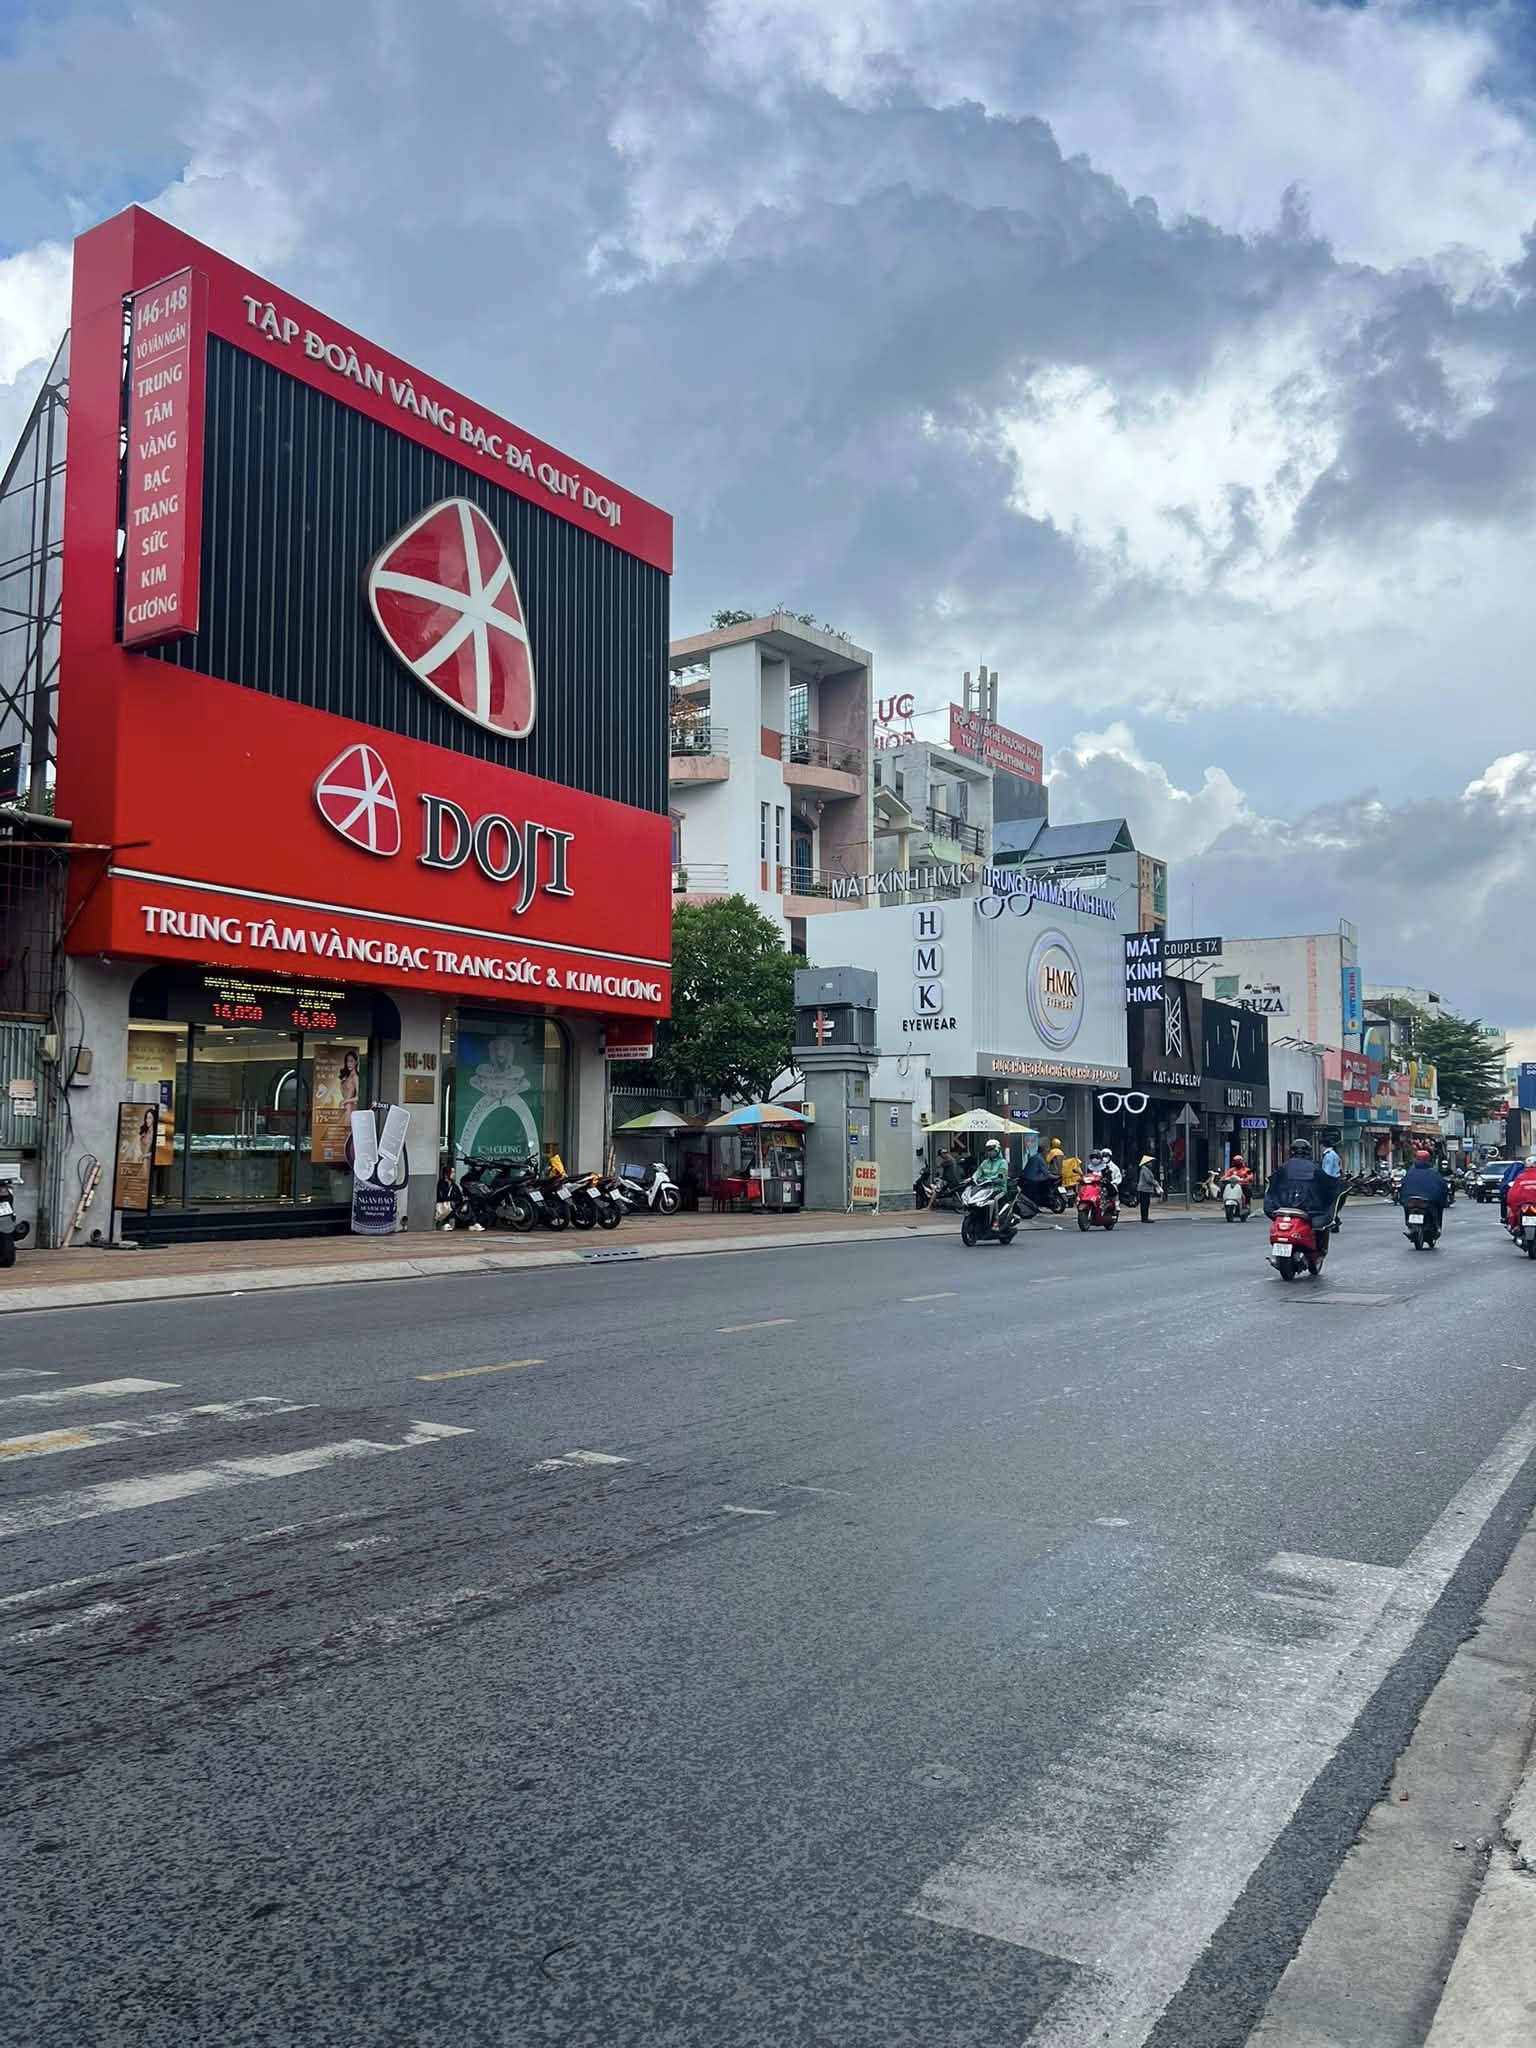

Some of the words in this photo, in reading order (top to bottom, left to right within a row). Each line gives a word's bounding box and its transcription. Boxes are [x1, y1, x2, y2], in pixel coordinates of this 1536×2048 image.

[137, 285, 188, 331] 146-148
[137, 363, 183, 399] TRUNG
[144, 400, 173, 427] TÂM
[242, 294, 300, 344] TẬP
[303, 329, 384, 396] ĐOÀN
[388, 376, 456, 435] VÀNG
[459, 417, 502, 459] BẠC
[506, 442, 536, 480] ĐÁ
[537, 463, 581, 502] QUÝ
[582, 485, 622, 527] DOJI
[139, 431, 177, 460] VÀNG
[143, 465, 171, 492] BẠC
[133, 494, 179, 527] TRANG
[141, 530, 169, 556] SỨC
[141, 563, 167, 589] KIM
[128, 592, 177, 624] CƯƠNG
[416, 793, 575, 914] DOJI
[874, 867, 919, 894] KÍNH
[924, 863, 973, 888] HMK
[982, 864, 1024, 893] TRUNG
[140, 905, 243, 945] TRUNG
[245, 918, 307, 954] TÂM
[309, 927, 383, 965] VÀNG
[383, 939, 429, 972] BẠC
[432, 949, 503, 980] TRANG
[504, 957, 542, 986] SỨC
[545, 967, 562, 989] &
[565, 970, 602, 994] KIM
[603, 976, 662, 1002] CƯƠNG
[1164, 941, 1201, 956] COUPLE
[1204, 940, 1218, 953] TX
[1044, 965, 1078, 998] HMK
[1126, 958, 1162, 981] KÍNH
[1046, 996, 1074, 1010] EYEWEAR
[1126, 984, 1164, 1003] HMK
[902, 1016, 957, 1032] EYEWEAR
[1152, 1070, 1167, 1084] KAT
[1171, 1072, 1201, 1087] JEWELRY
[1242, 1119, 1266, 1128] RUZA
